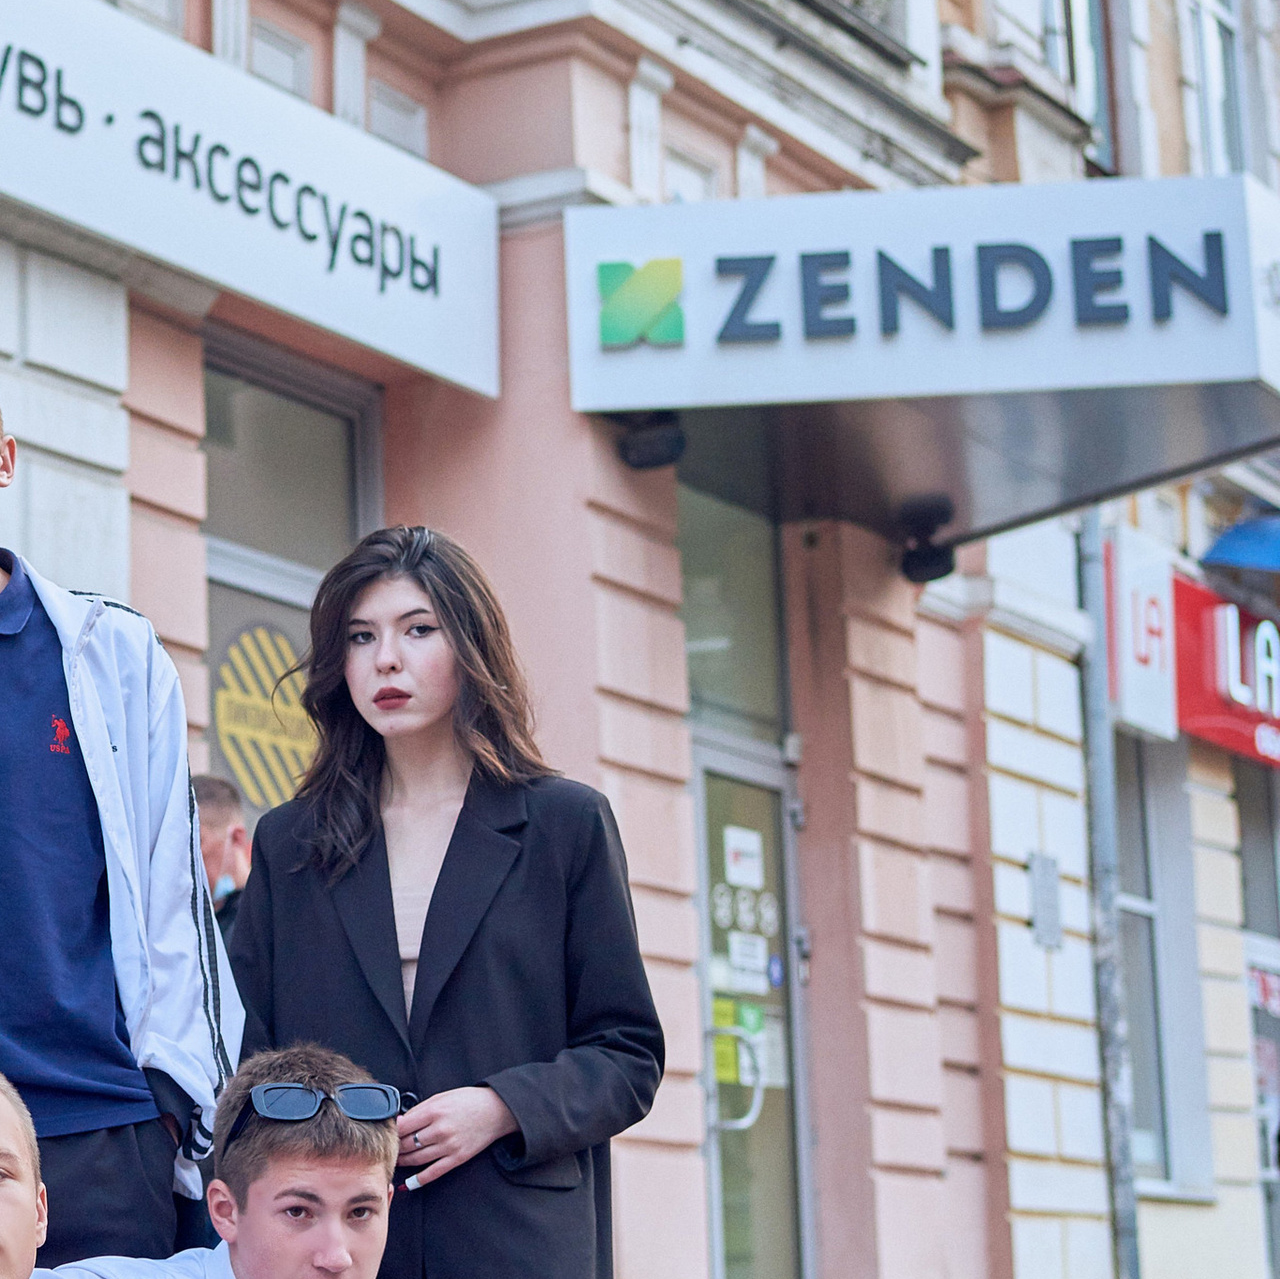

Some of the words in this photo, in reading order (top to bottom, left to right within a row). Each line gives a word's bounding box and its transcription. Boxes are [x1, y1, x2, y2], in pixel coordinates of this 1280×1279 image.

[137, 108, 442, 297] аксессуары
[715, 230, 1231, 345] ZENDEN
[49, 744, 71, 755] USPA
